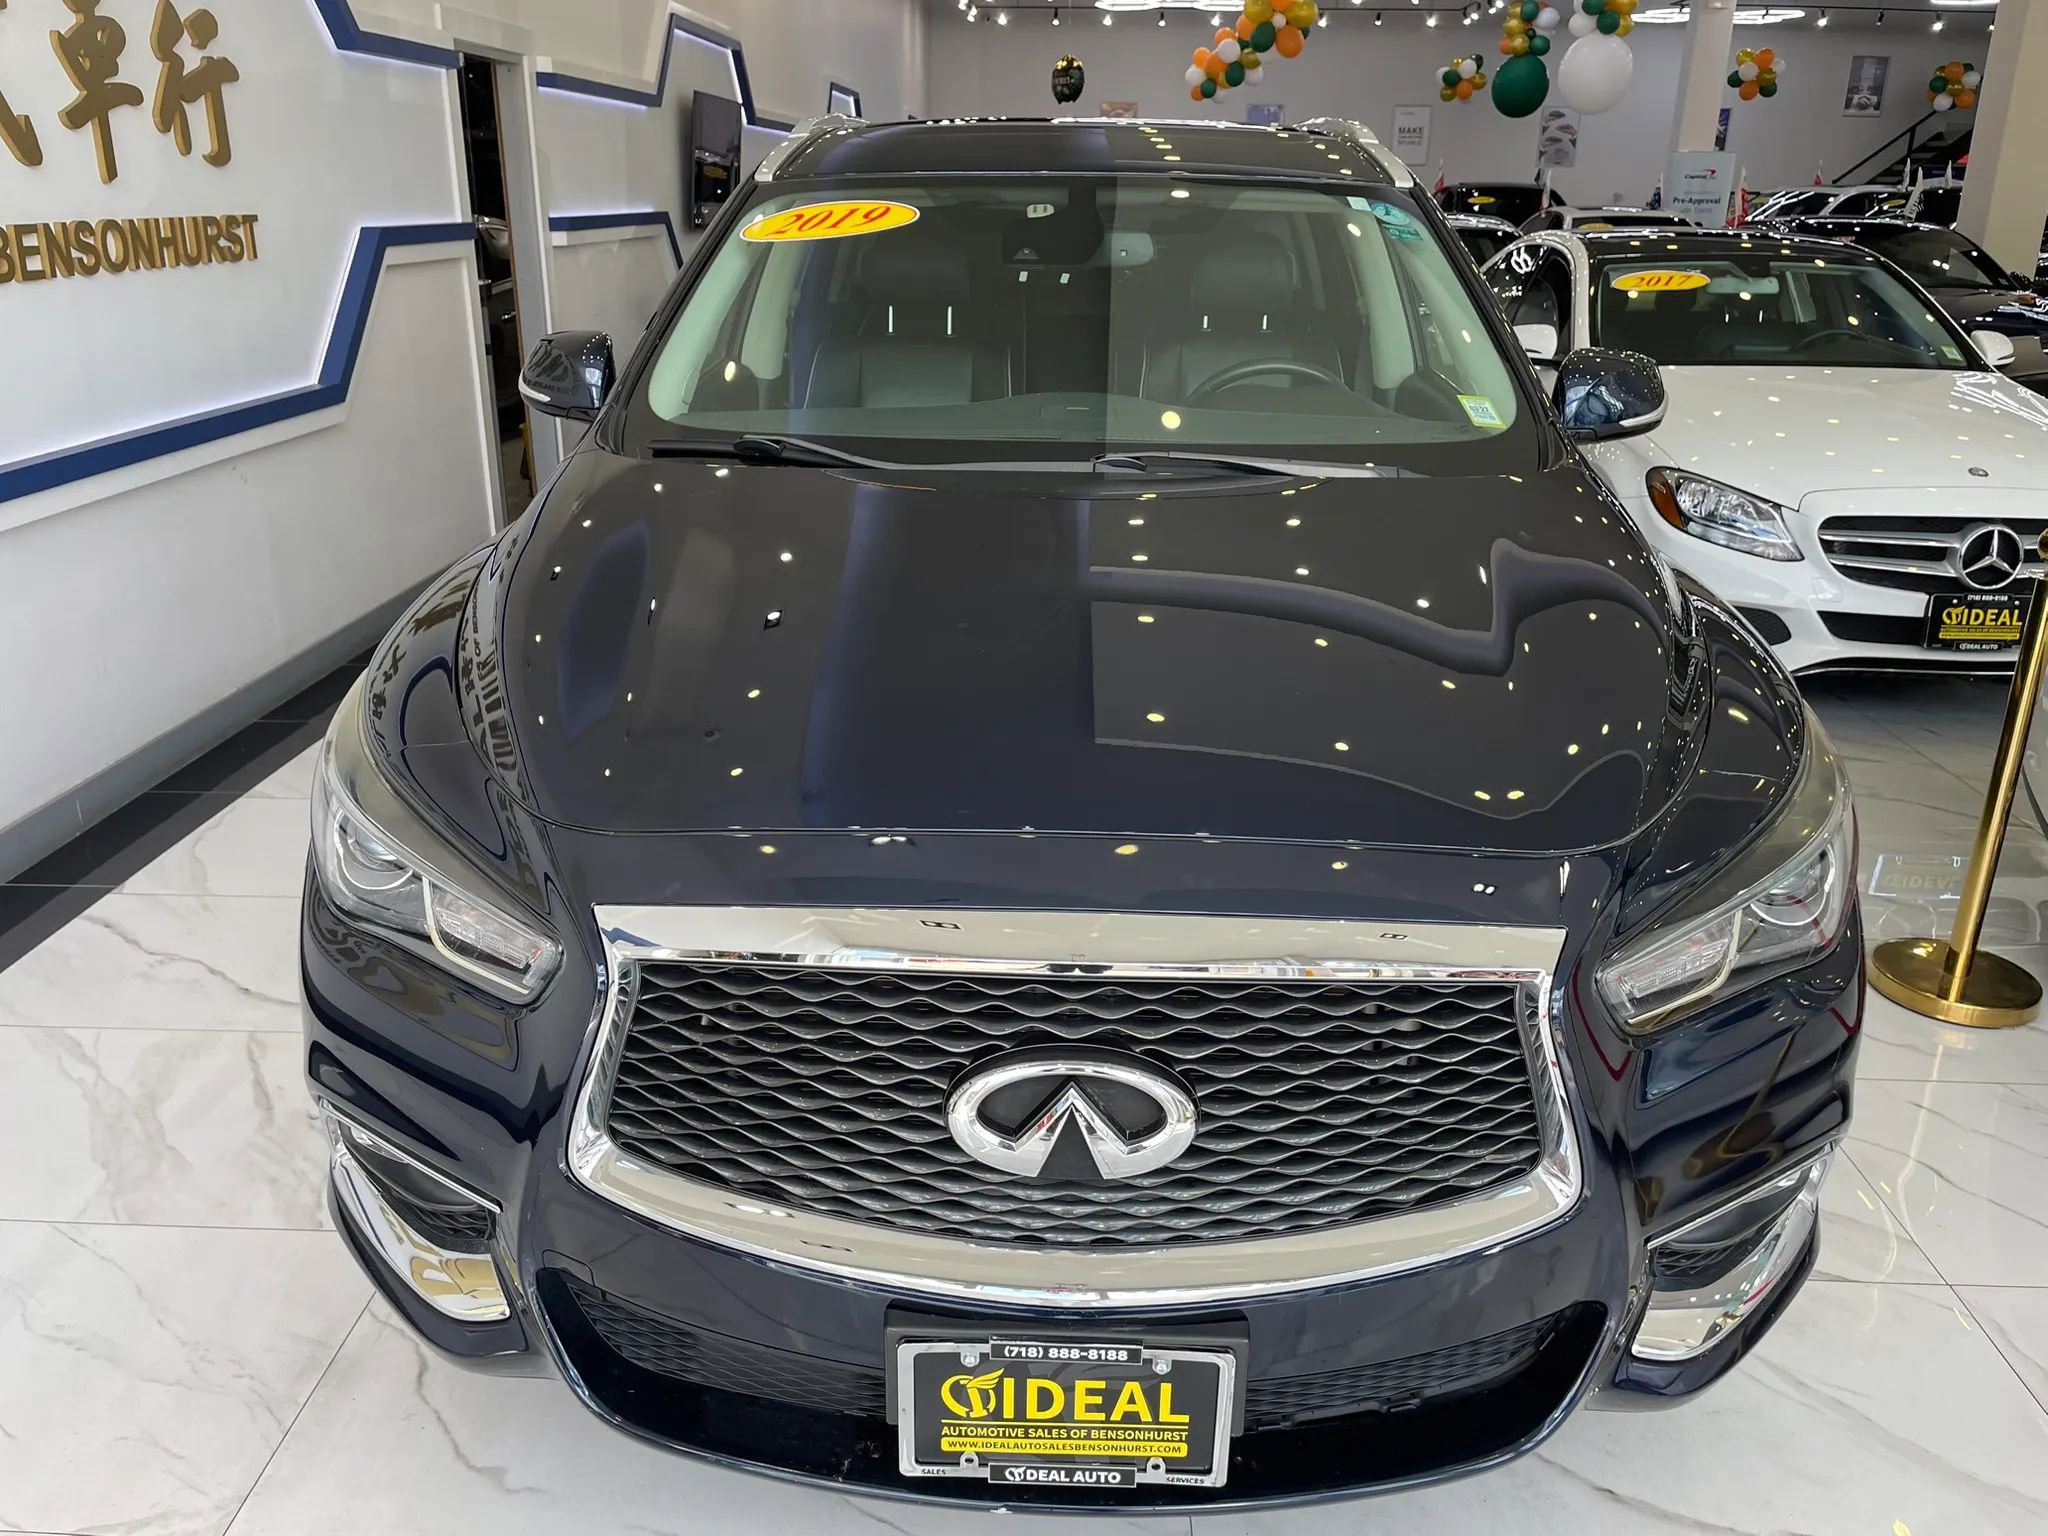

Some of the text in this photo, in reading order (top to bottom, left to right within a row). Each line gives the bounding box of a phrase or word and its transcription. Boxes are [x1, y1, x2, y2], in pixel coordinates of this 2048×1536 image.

[1672, 196, 1721, 206] Pre-Approval
[765, 205, 891, 237] 2019
[1631, 274, 1694, 288] 2017
[1962, 607, 2023, 626] IDEAL
[1004, 1345, 1128, 1361] (718) 888-8188
[1003, 1377, 1190, 1423] IDEAL
[941, 1425, 1188, 1442] AUTOMOTIVE SALES OF BENSONHURST
[948, 1440, 1181, 1454] WWW.IDEALAUTOSALESBENSONHURST.COM
[1071, 1470, 1121, 1484] AUTO
[1166, 1475, 1205, 1485] SERVICES
